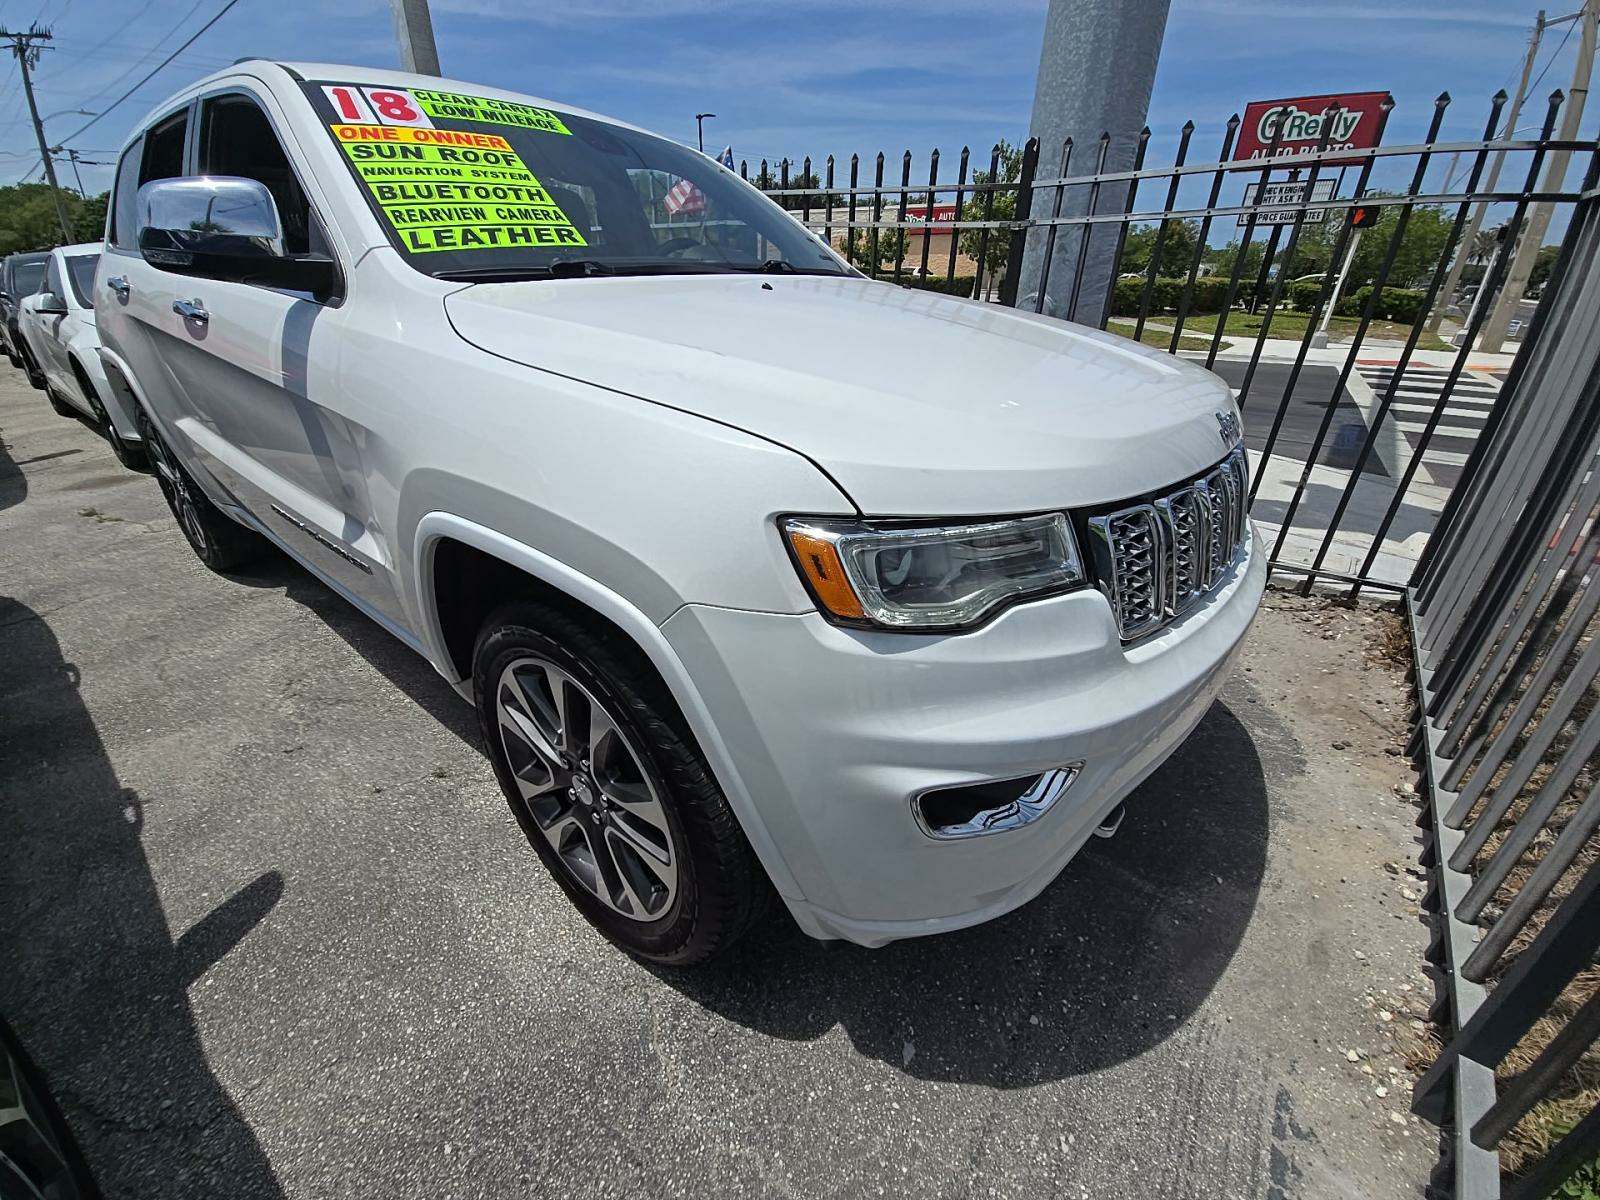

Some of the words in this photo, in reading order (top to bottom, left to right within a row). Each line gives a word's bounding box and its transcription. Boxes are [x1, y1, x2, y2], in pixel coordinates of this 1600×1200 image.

[331, 88, 418, 121] 18
[414, 91, 479, 107] CLEAN
[486, 101, 556, 119] CARFAX
[430, 103, 476, 118] LOW
[480, 109, 559, 131] MILEAGE
[1258, 106, 1362, 143] O'Reily
[339, 127, 400, 141] ONE
[413, 130, 508, 149] OWNER
[352, 144, 424, 160] SUN
[437, 148, 517, 167] ROOF
[362, 166, 462, 177] NAVIGATION
[471, 169, 532, 182] SYSTEM
[376, 184, 546, 202] BLUETOOTH
[390, 206, 487, 224] REARVIEW
[495, 207, 565, 222] CAMERA
[409, 227, 581, 249] LEATHER
